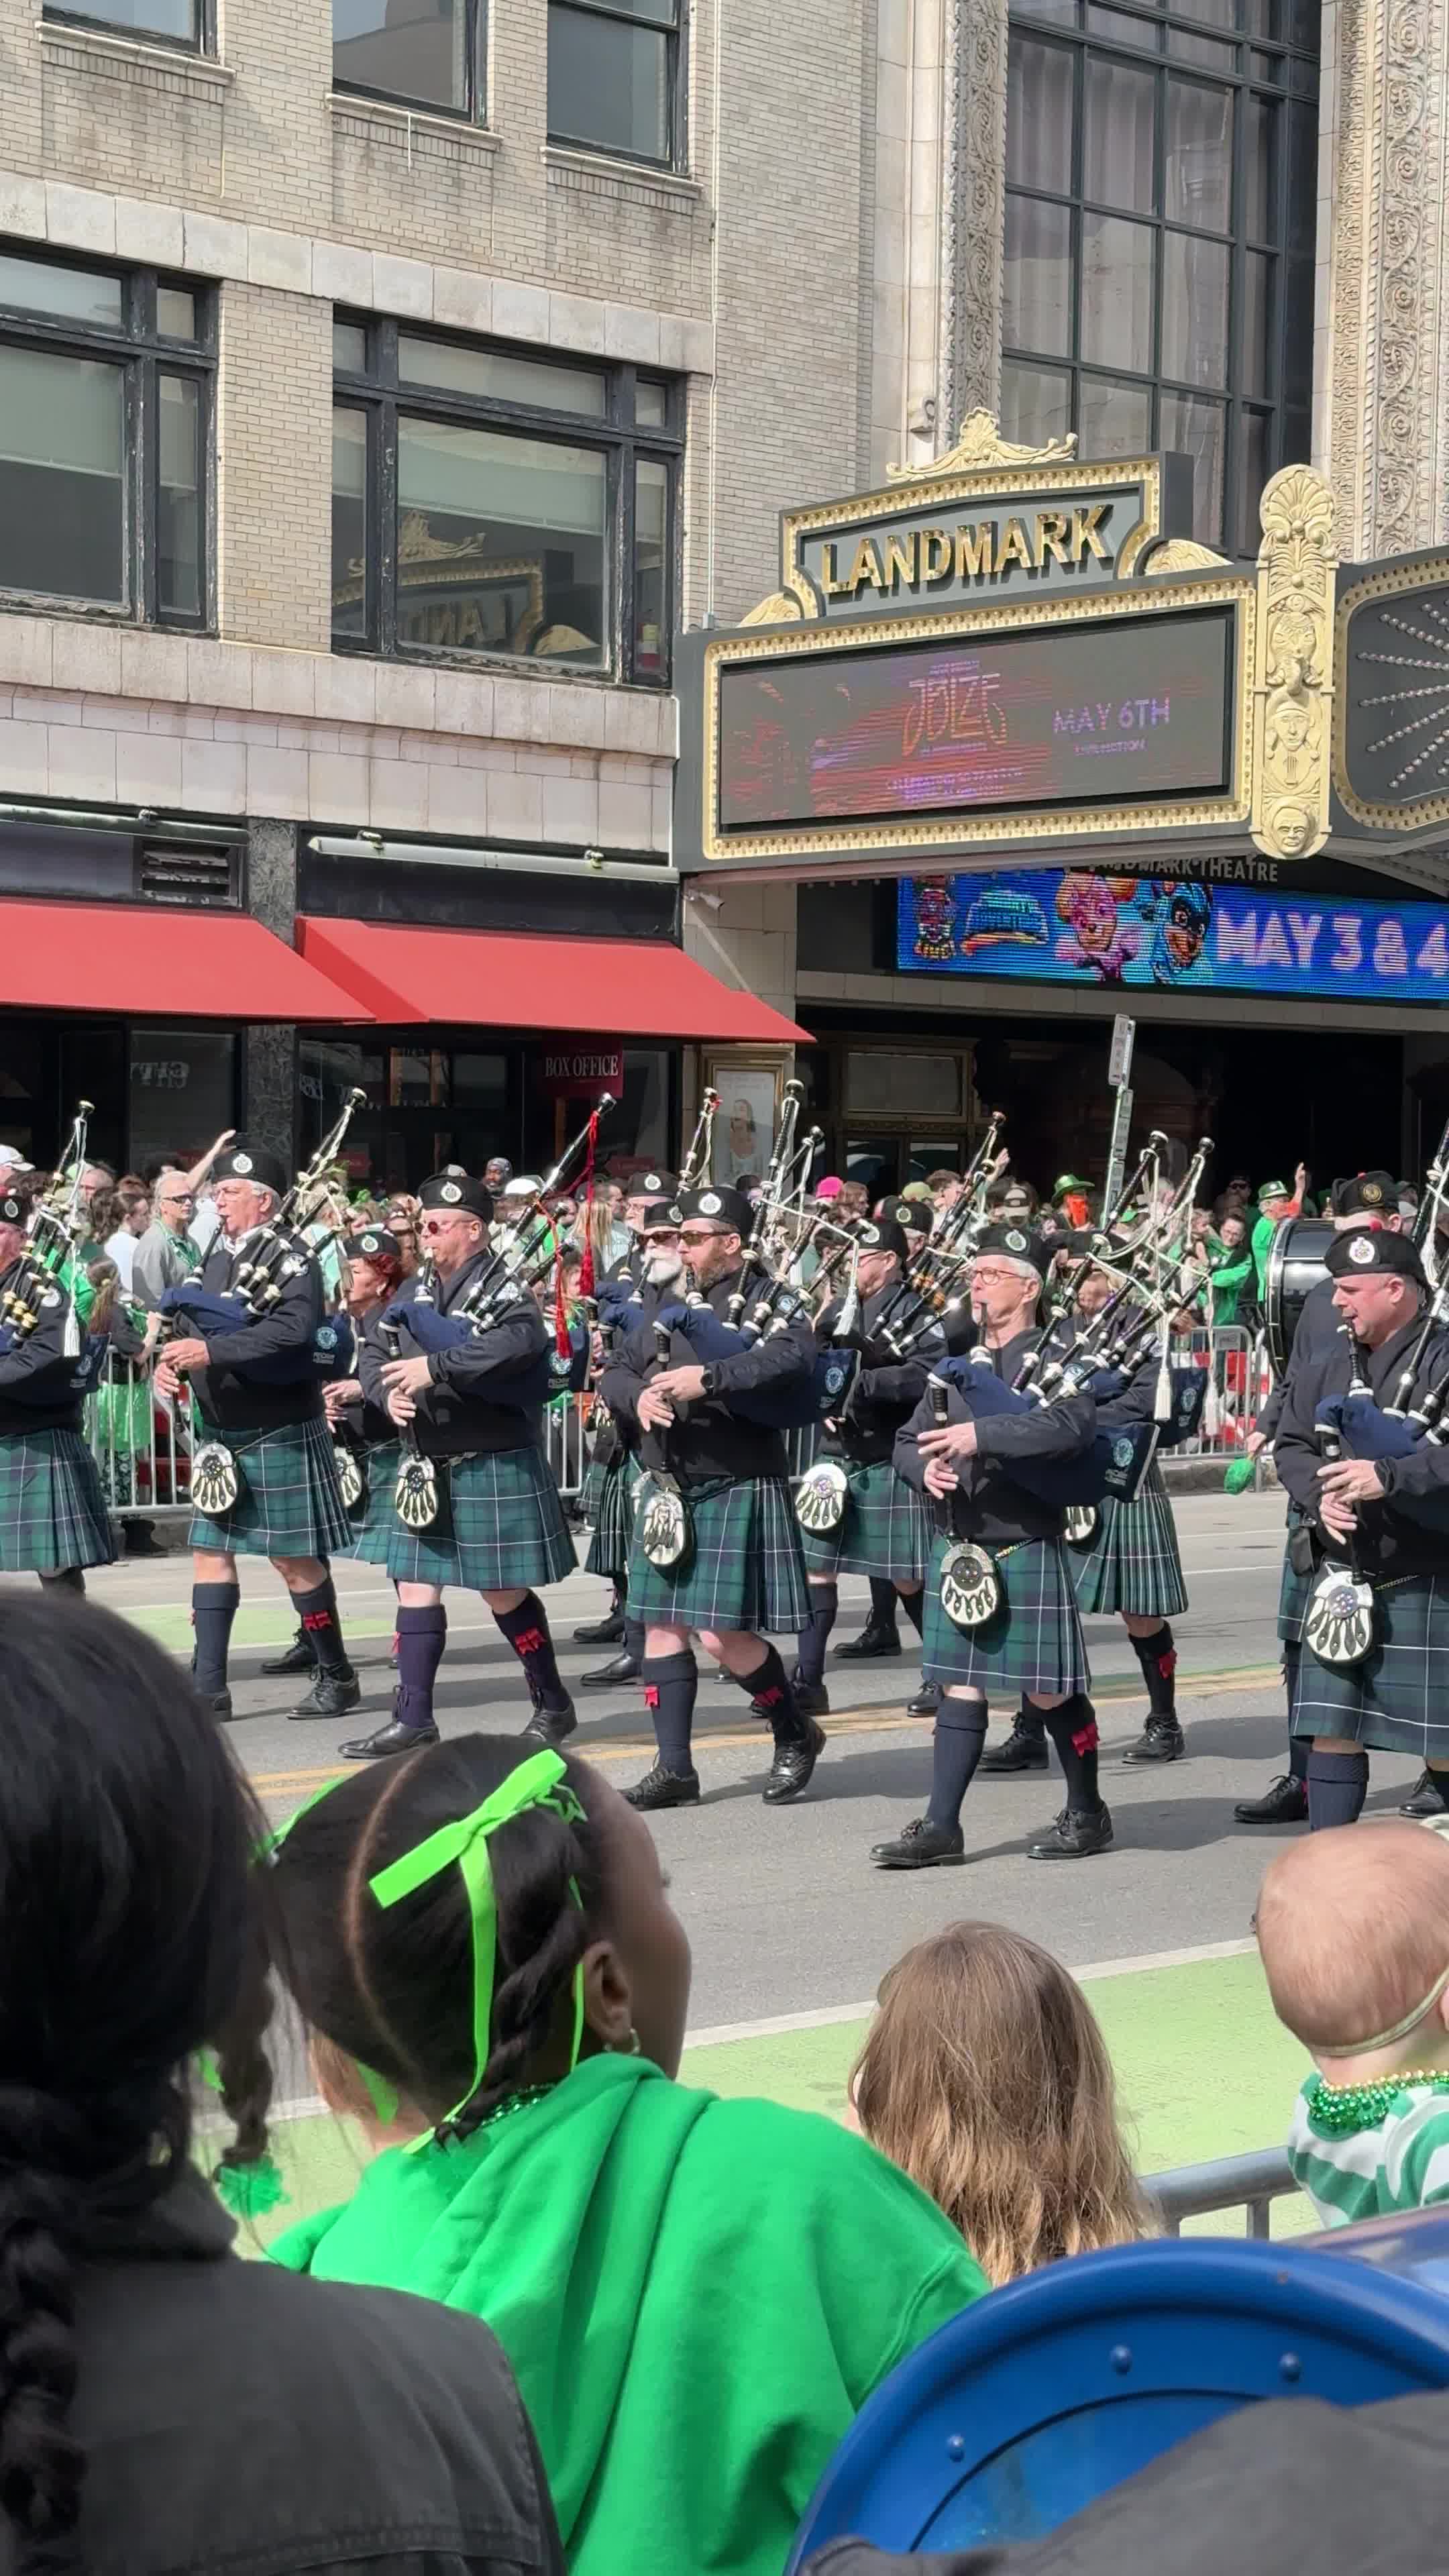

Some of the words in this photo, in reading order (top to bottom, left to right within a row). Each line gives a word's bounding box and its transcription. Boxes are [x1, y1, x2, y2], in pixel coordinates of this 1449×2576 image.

[822, 503, 1115, 594] LANDMARK
[1053, 704, 1113, 735] MAY
[1120, 697, 1170, 731] 6TH
[1201, 855, 1278, 882] THEATRE
[1217, 910, 1323, 968] MAY
[1331, 915, 1362, 971] 3
[1373, 920, 1407, 977] &
[1416, 923, 1449, 977] 4
[545, 1057, 570, 1077] BOX
[573, 1055, 619, 1077] OFFICE
